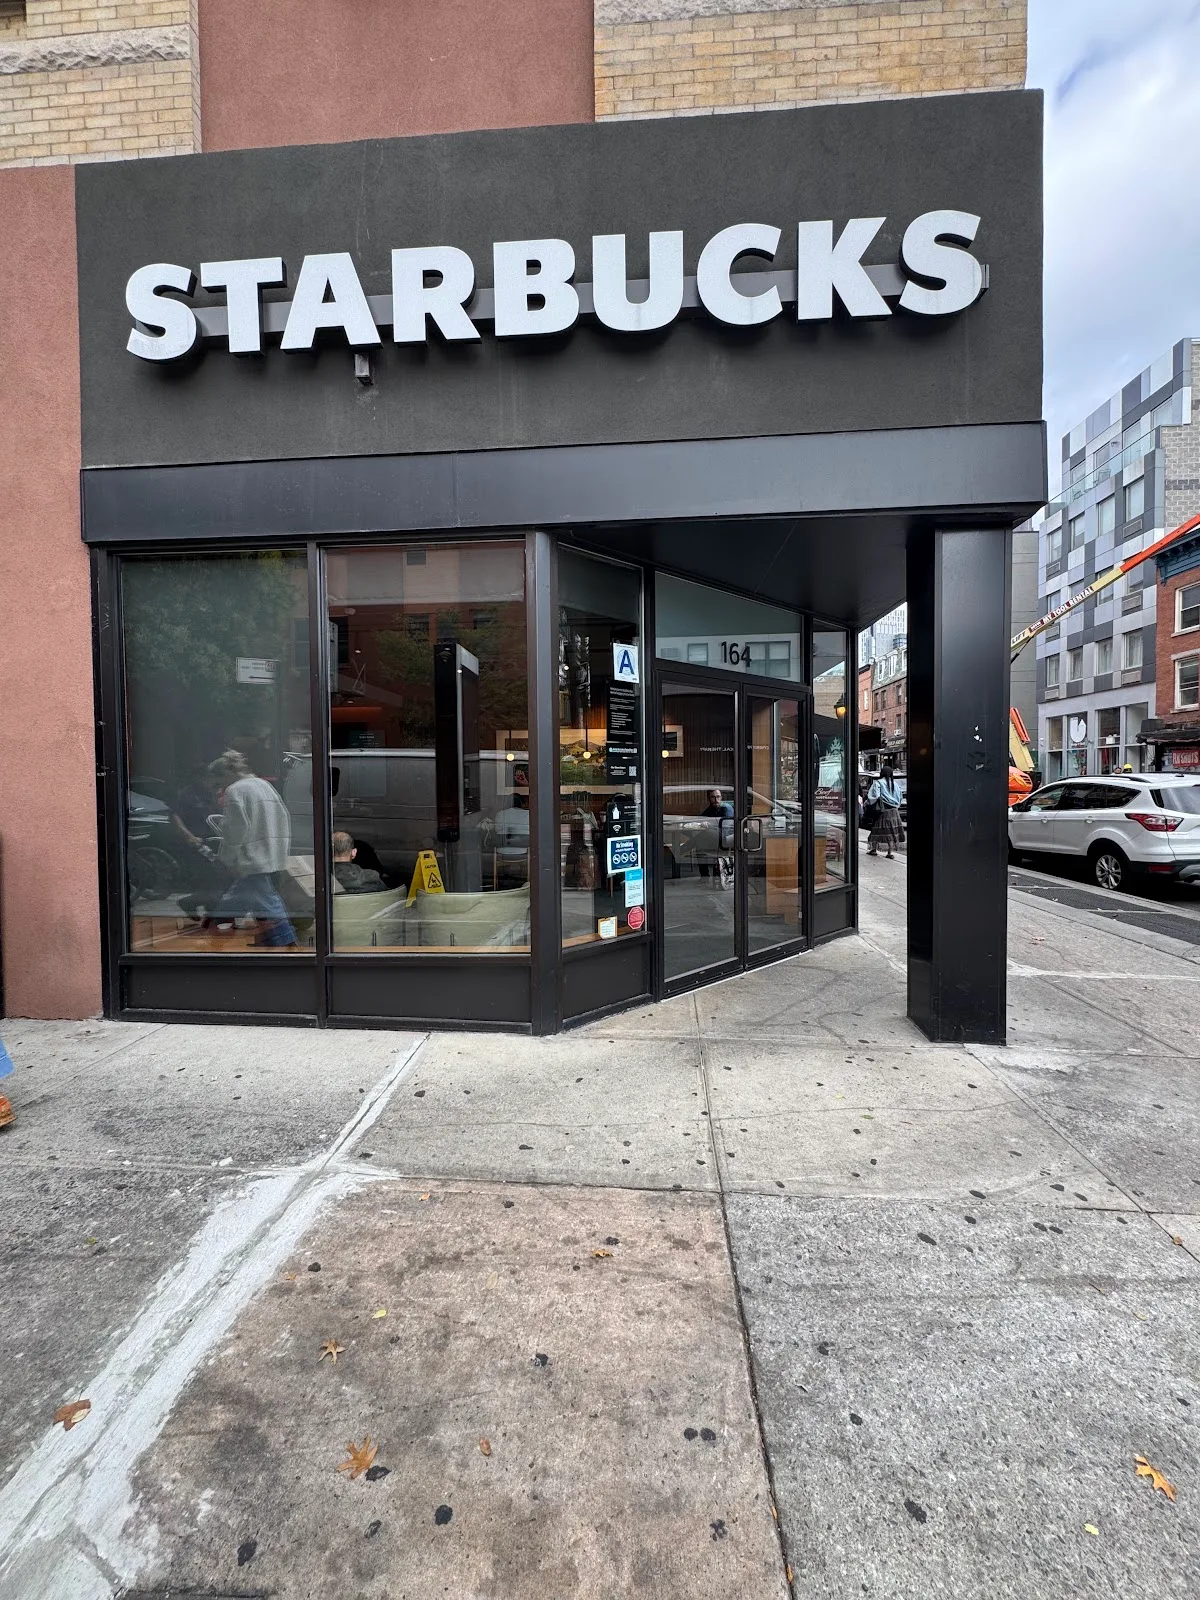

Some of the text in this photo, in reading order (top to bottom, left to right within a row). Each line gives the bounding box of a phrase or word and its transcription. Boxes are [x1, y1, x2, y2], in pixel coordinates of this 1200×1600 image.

[124, 209, 982, 362] STARBUCKS
[1042, 587, 1093, 625] MY TOOL RENTAL
[1011, 630, 1026, 645] LIFT
[618, 649, 635, 675] A
[721, 641, 752, 667] 164
